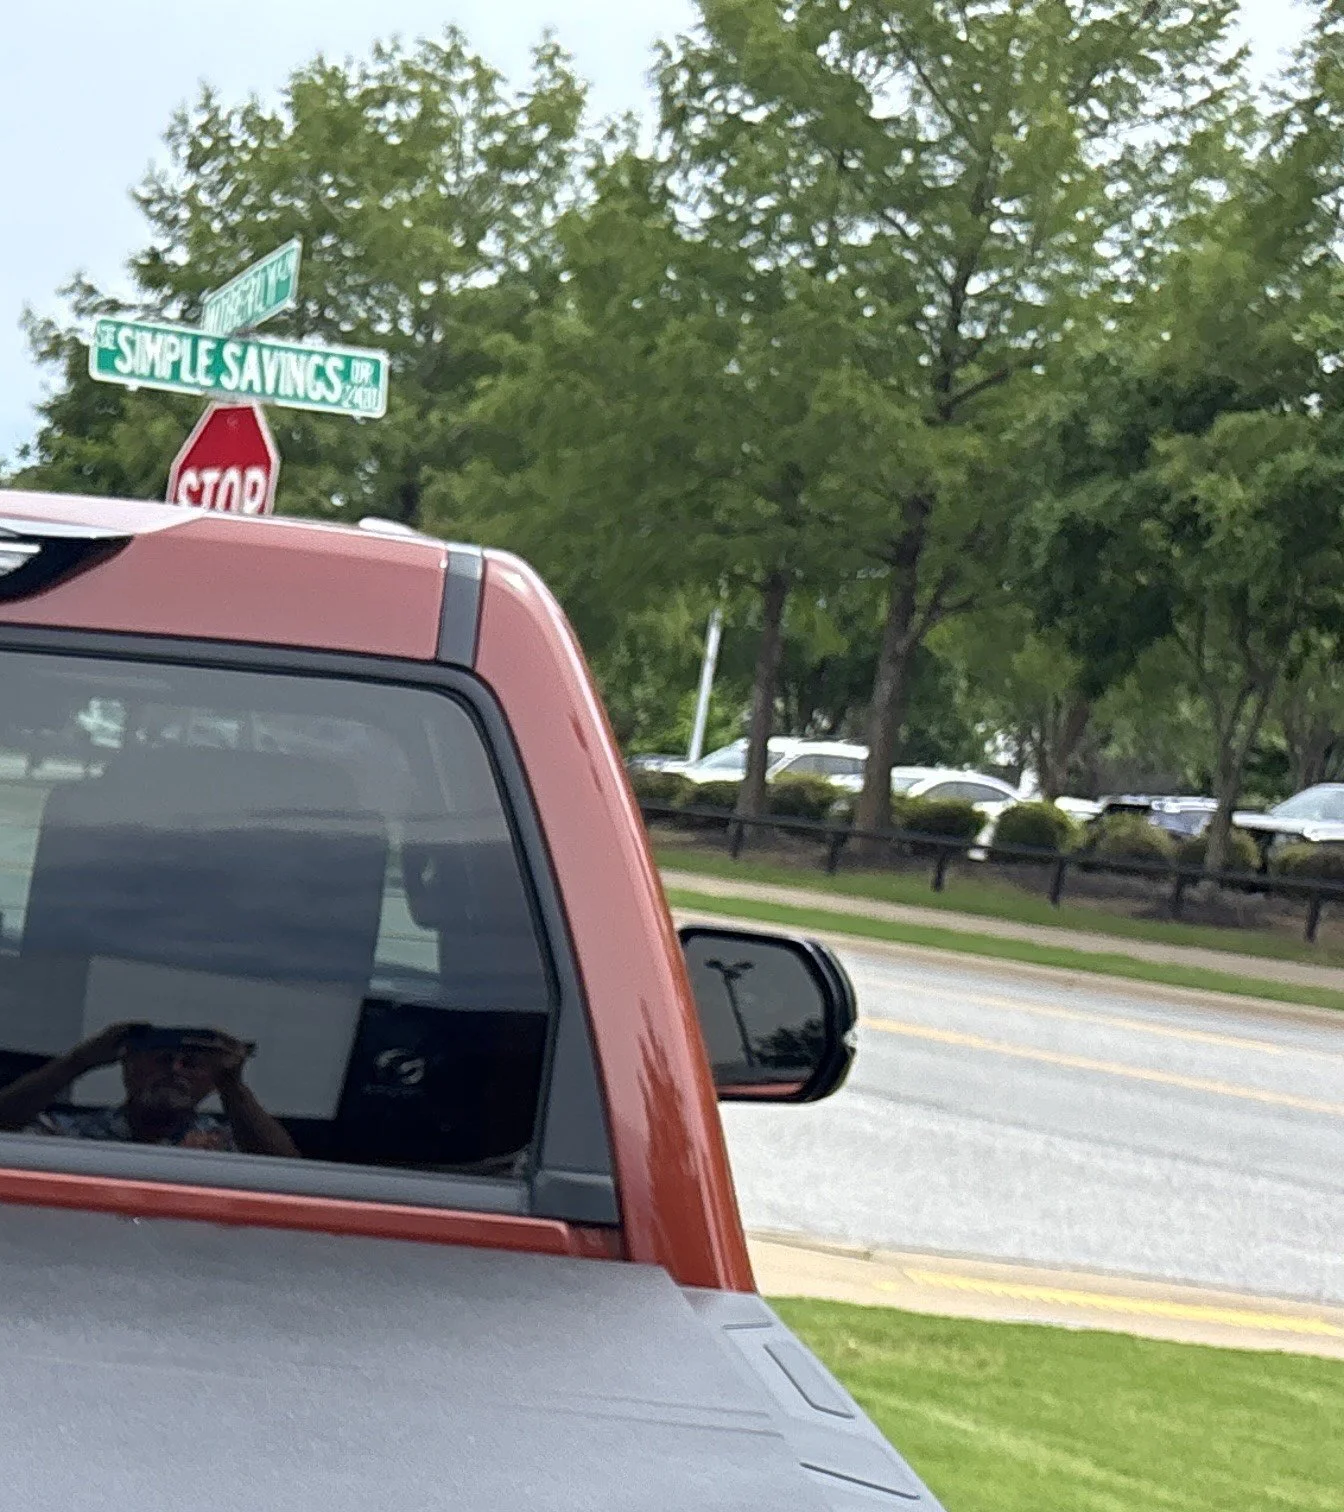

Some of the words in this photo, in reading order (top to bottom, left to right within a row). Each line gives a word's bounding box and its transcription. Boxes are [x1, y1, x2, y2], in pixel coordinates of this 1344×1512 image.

[114, 325, 217, 387] SIMPLE
[219, 341, 345, 404] SAVINGS
[177, 466, 267, 514] STOP
